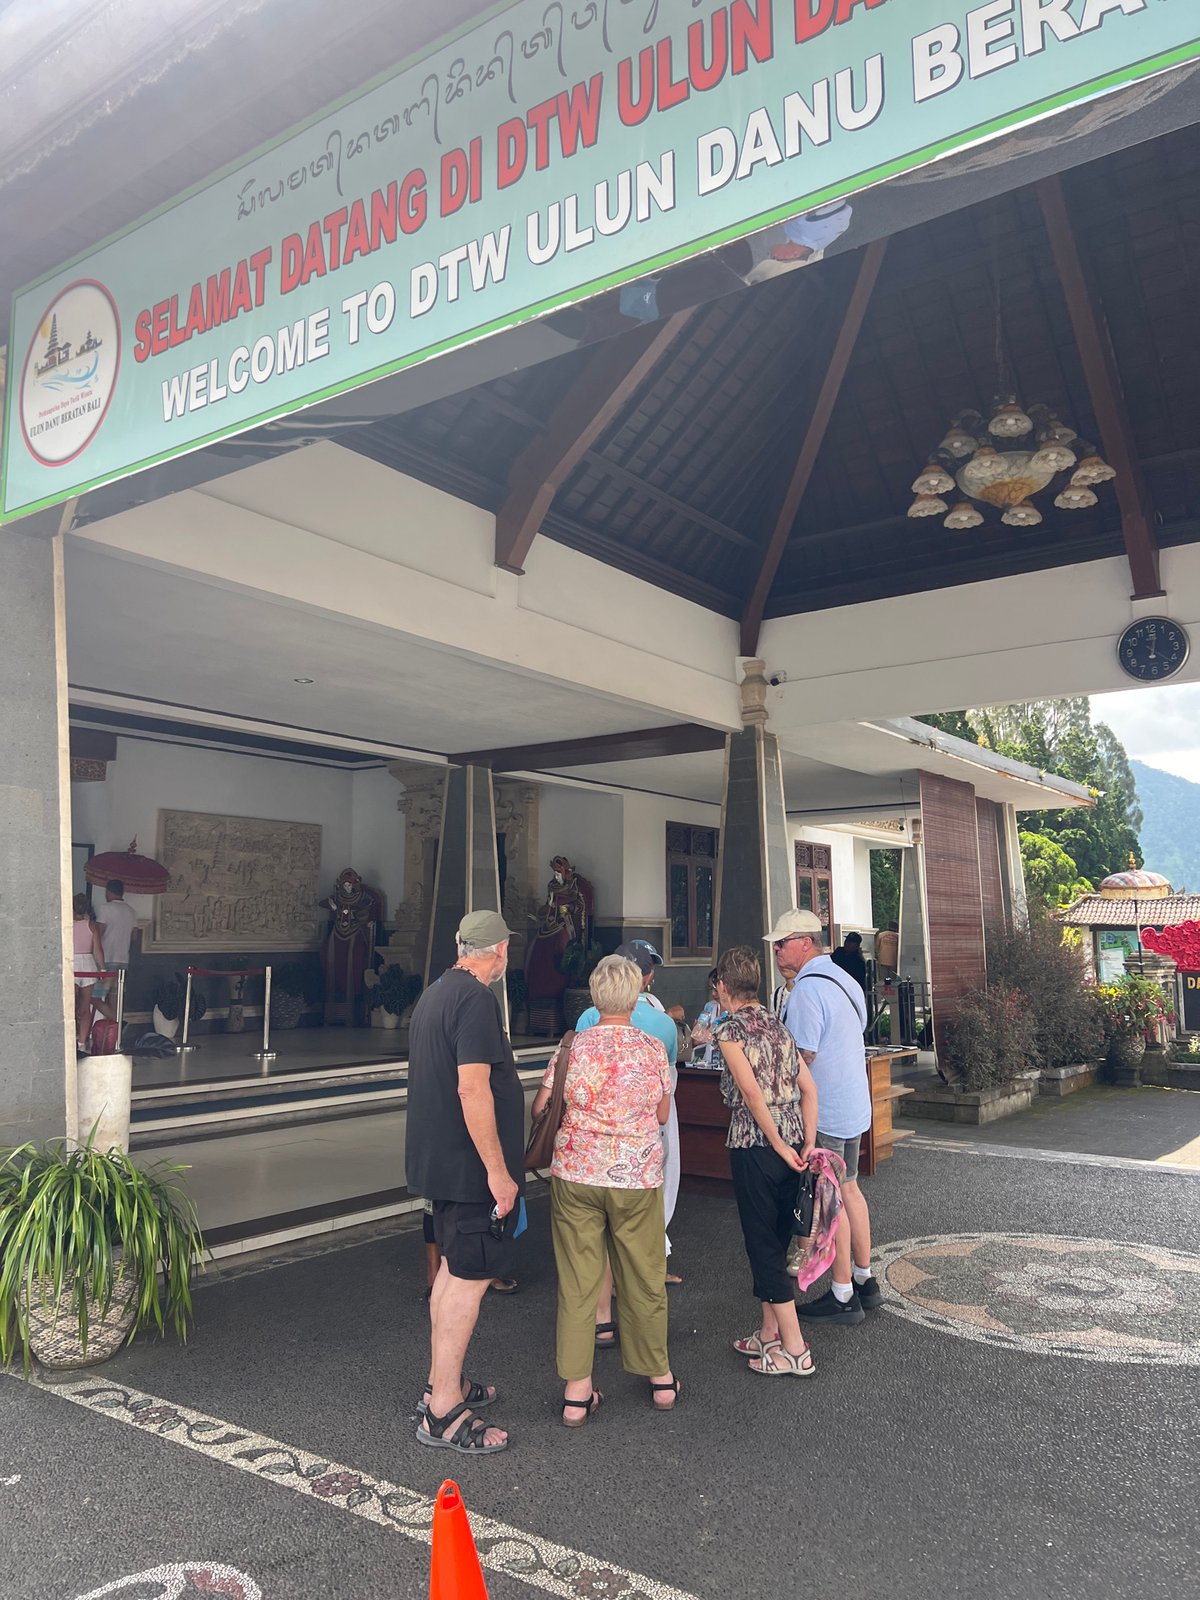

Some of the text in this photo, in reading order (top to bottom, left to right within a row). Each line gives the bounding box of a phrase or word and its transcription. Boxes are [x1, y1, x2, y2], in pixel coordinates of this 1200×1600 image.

[133, 246, 272, 363] SELAMAT
[280, 168, 428, 295] DATANG
[440, 136, 482, 218] DI
[497, 72, 603, 190] DTW
[617, 0, 773, 126] ULUN
[161, 307, 330, 422] WELCOME
[342, 281, 396, 344] TO
[410, 224, 511, 318] DTW
[527, 149, 675, 265] ULUN
[697, 53, 884, 196] DANU
[45, 416, 61, 431] DANU
[87, 397, 101, 413] BALI
[1145, 624, 1156, 633] 12
[1160, 625, 1165, 634] 1
[1135, 629, 1144, 638] 11
[1168, 631, 1175, 641] 2
[1127, 637, 1138, 647] 10
[1173, 641, 1179, 651] 3
[1126, 648, 1133, 657] 9
[1130, 658, 1137, 667] 8
[1163, 661, 1170, 670] 5
[1139, 665, 1146, 674] 7
[1151, 666, 1158, 675] 6
